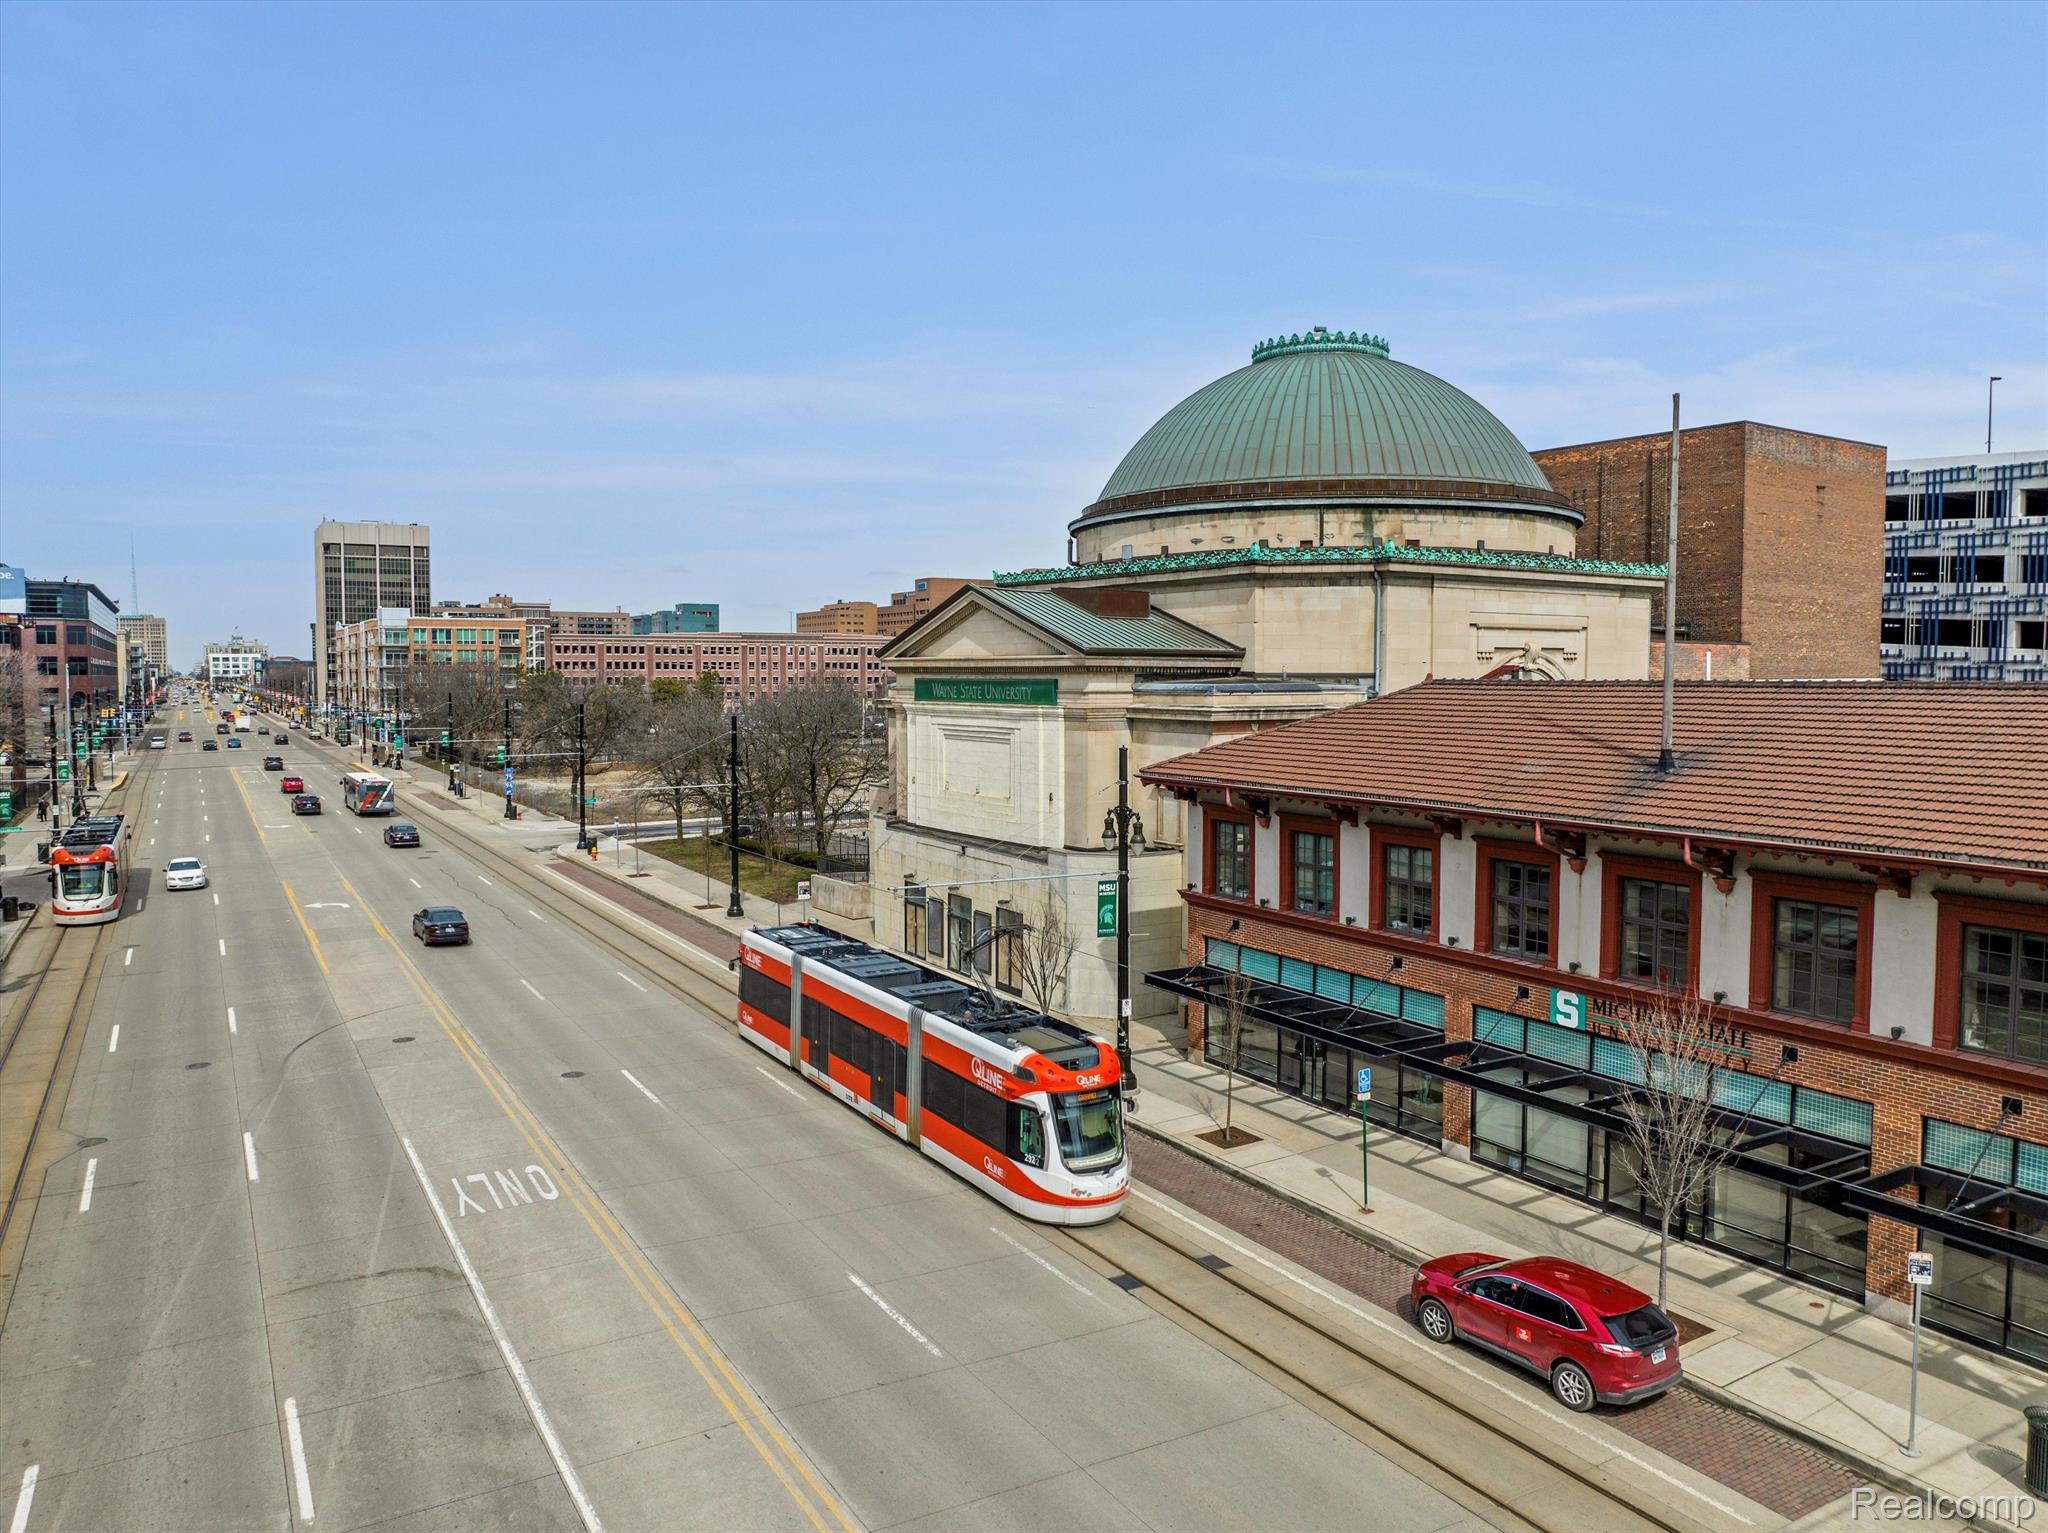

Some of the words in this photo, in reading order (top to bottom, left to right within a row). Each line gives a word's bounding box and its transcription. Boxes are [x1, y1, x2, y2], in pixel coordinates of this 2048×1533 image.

[932, 682, 957, 698] WAYNE
[960, 683, 982, 699] STATE
[984, 683, 1032, 700] UNIVERSITY
[1098, 884, 1116, 892] MSU
[1556, 990, 1579, 1028] S
[971, 1056, 1004, 1090] QLINE
[1075, 1074, 1101, 1086] QLINE
[983, 1155, 1004, 1178] QLINE
[451, 1164, 560, 1217] ONLY
